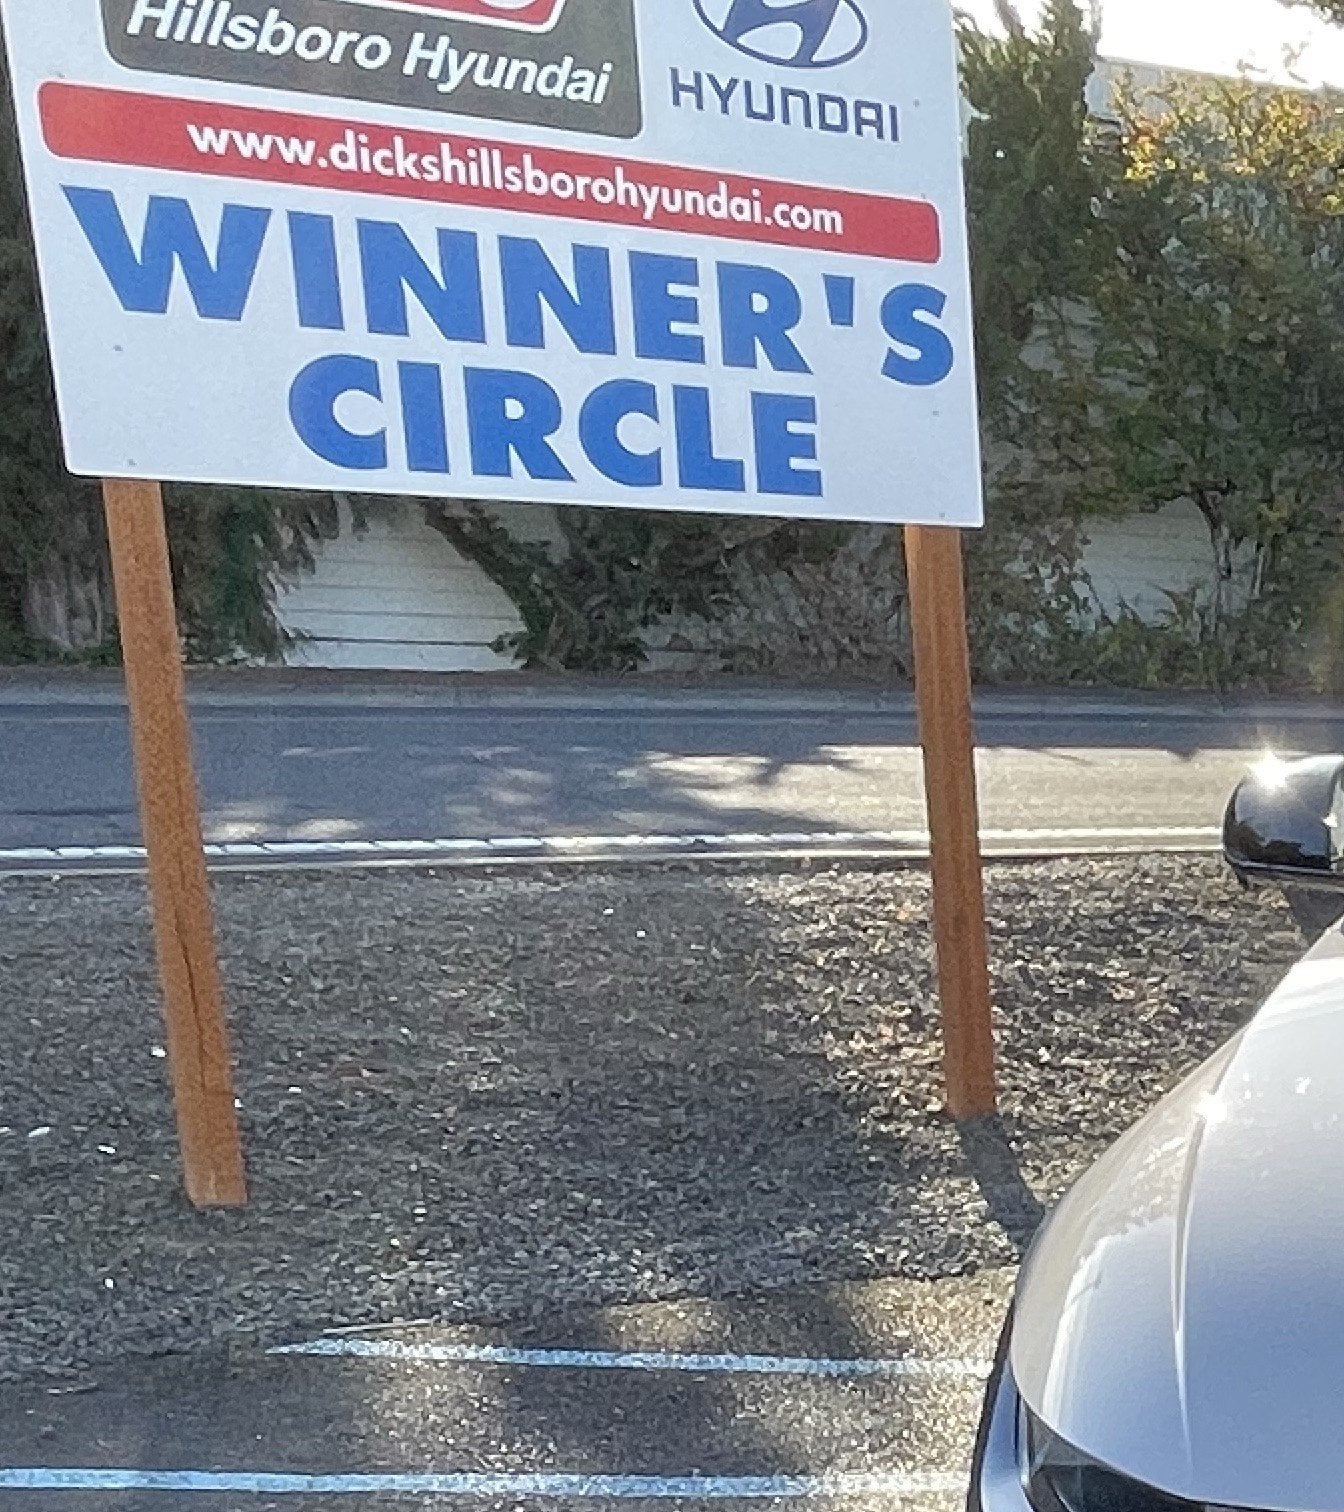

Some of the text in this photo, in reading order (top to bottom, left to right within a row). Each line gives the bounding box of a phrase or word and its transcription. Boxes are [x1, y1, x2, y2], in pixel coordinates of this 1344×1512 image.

[127, 0, 613, 104] Hillsboro Hyundai
[671, 66, 900, 142] HYUNDAI
[187, 123, 844, 236] www.dickshillsborohyundai.com
[60, 184, 954, 386] WINNER'S
[288, 354, 823, 497] CIRCLE
